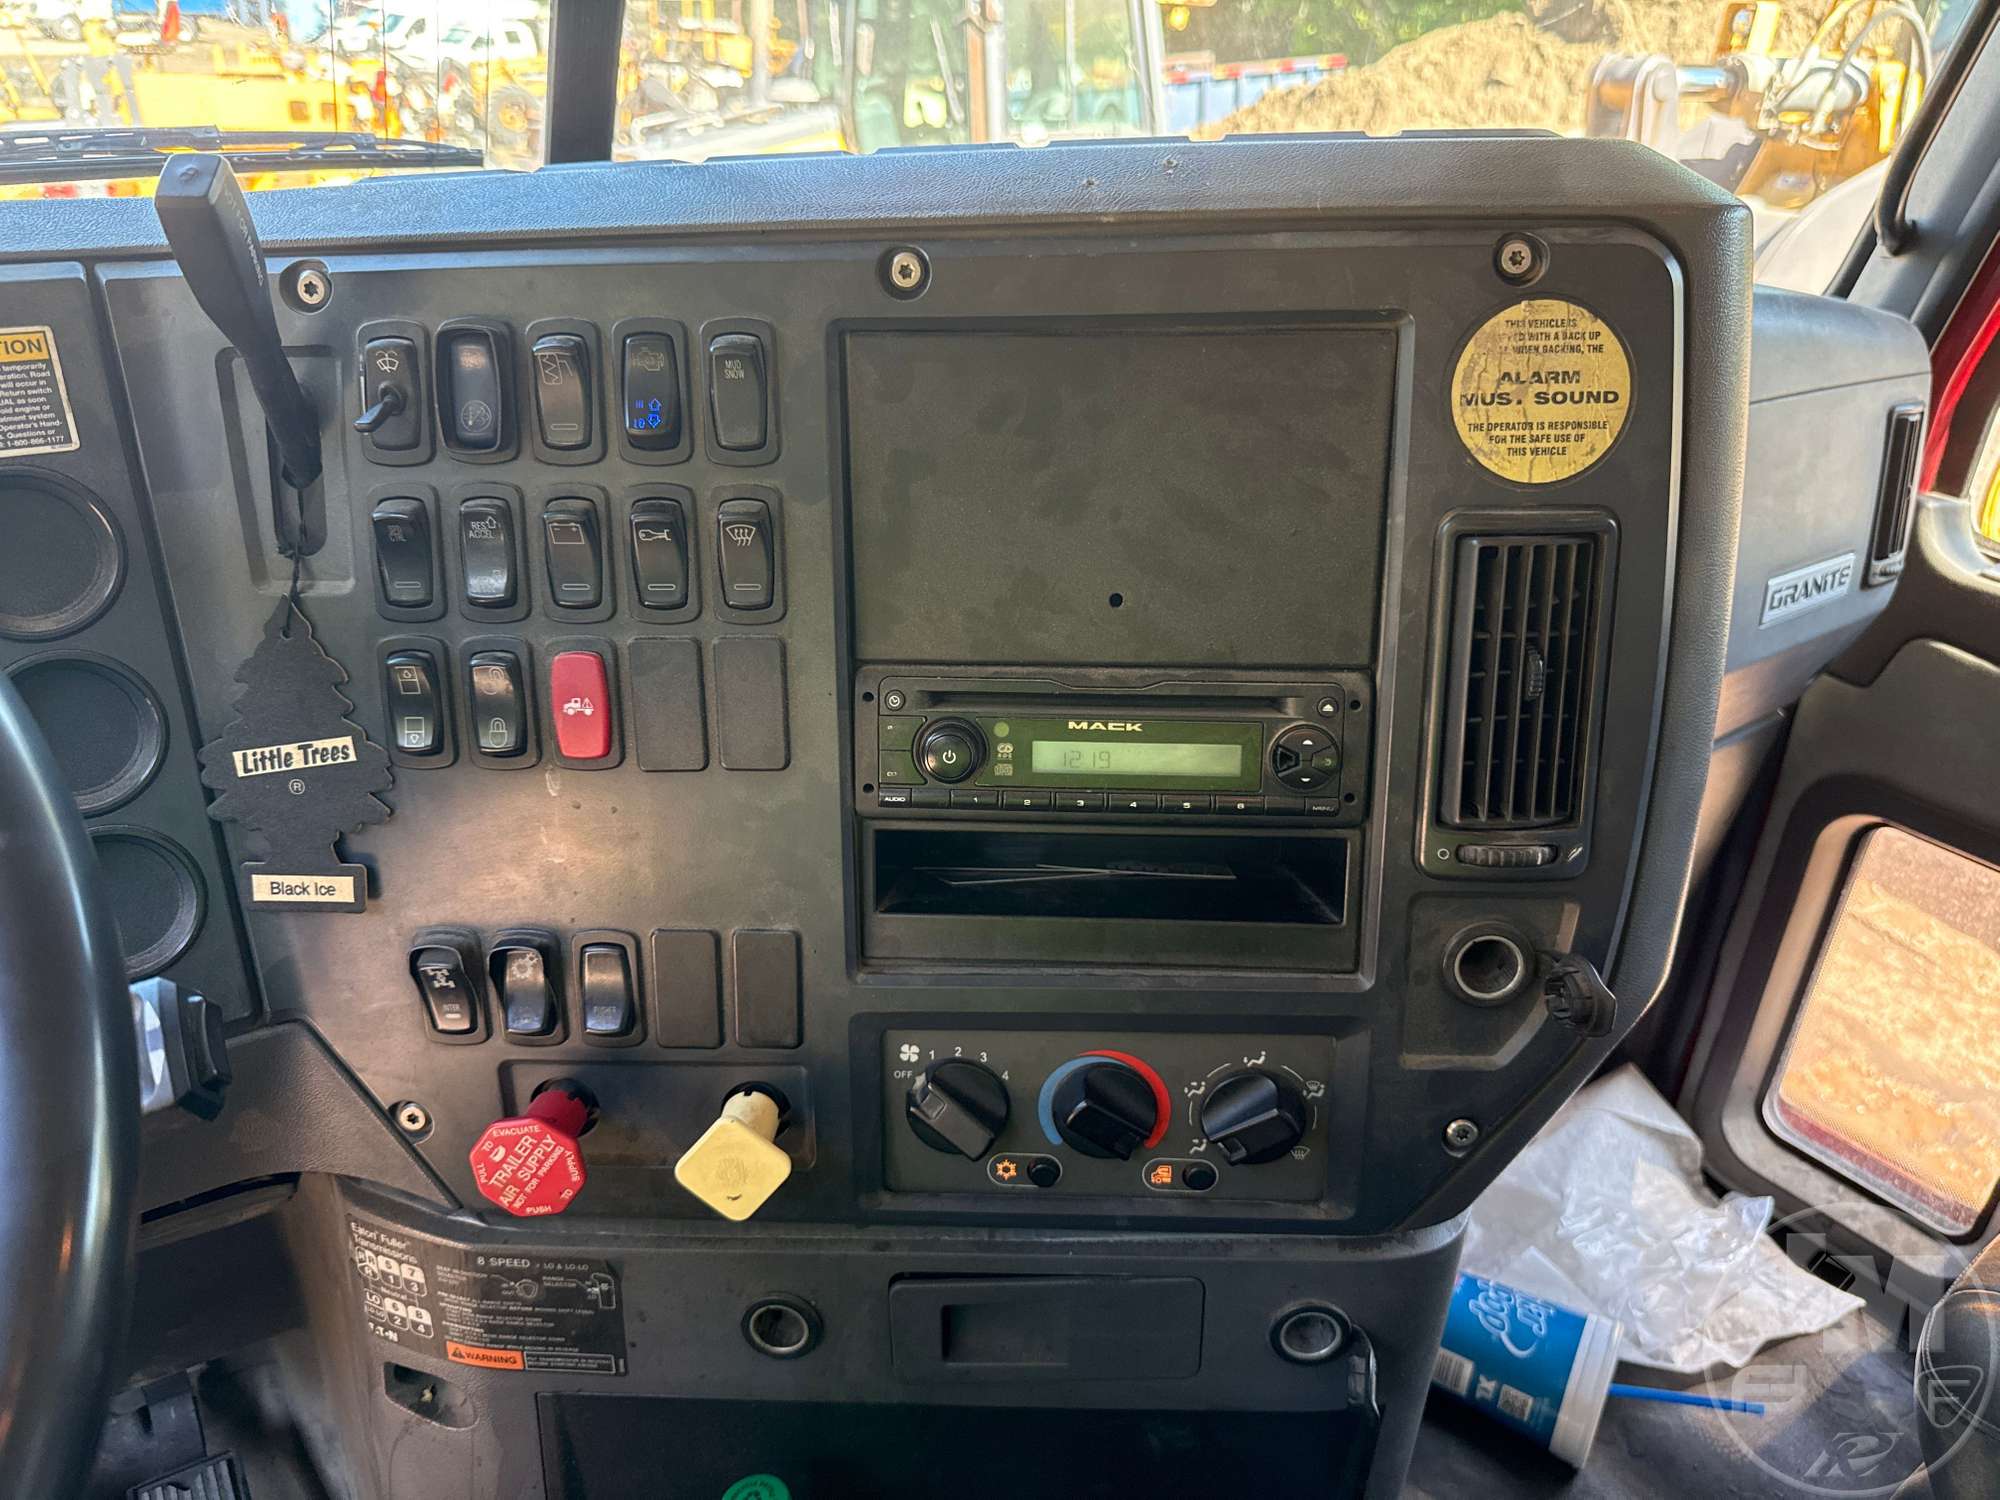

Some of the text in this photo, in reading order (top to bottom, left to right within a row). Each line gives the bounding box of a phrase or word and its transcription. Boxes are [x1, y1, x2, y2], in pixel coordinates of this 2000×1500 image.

[1528, 319, 1566, 329] VEHICLE
[1567, 318, 1577, 328] IS
[1527, 331, 1550, 342] WITH
[1553, 331, 1560, 341] A
[1562, 331, 1587, 341] BACK
[1589, 331, 1601, 341] UP
[1587, 343, 1604, 353] THE
[2, 363, 47, 372] temporarily
[724, 359, 742, 370] MUD
[30, 370, 51, 378] Road
[723, 369, 745, 380] SNOW
[1499, 370, 1582, 385] ALARM
[27, 387, 53, 396] switch
[1534, 390, 1620, 405] SOUND
[15, 405, 41, 413] engine
[29, 413, 55, 421] system
[1467, 420, 1608, 432] THE OPERATOR IS RESPONSIBLE
[7, 430, 46, 439] Questions
[1489, 433, 1586, 444] FOR THE SAFE USE OF
[1507, 446, 1567, 457] THIS VEHICLE
[1769, 565, 1851, 610] GRANITE
[1068, 721, 1143, 732] MACK
[242, 743, 351, 775] Little Trees
[1024, 799, 1031, 807] 2
[270, 881, 337, 897] Black Ice
[929, 1050, 935, 1060] 1
[954, 1046, 962, 1057] 2
[980, 1051, 988, 1062] 3
[893, 1070, 913, 1079] OFF
[1001, 1070, 1009, 1080] 4
[492, 1125, 541, 1137] EVACUATE
[482, 1140, 494, 1151] TO
[488, 1135, 538, 1188] TRAILER
[565, 1150, 581, 1182] SUPPLY
[499, 1133, 557, 1207] AIR SUPPLY
[512, 1193, 527, 1209] NOT
[525, 1178, 541, 1193] FOR
[560, 1188, 574, 1200] TO
[525, 1205, 552, 1215] PUSH
[477, 1256, 485, 1266] 8
[489, 1256, 531, 1268] SPEED
[407, 1267, 416, 1277] 7
[393, 1317, 401, 1326] 2
[464, 1352, 517, 1365] WARNING
